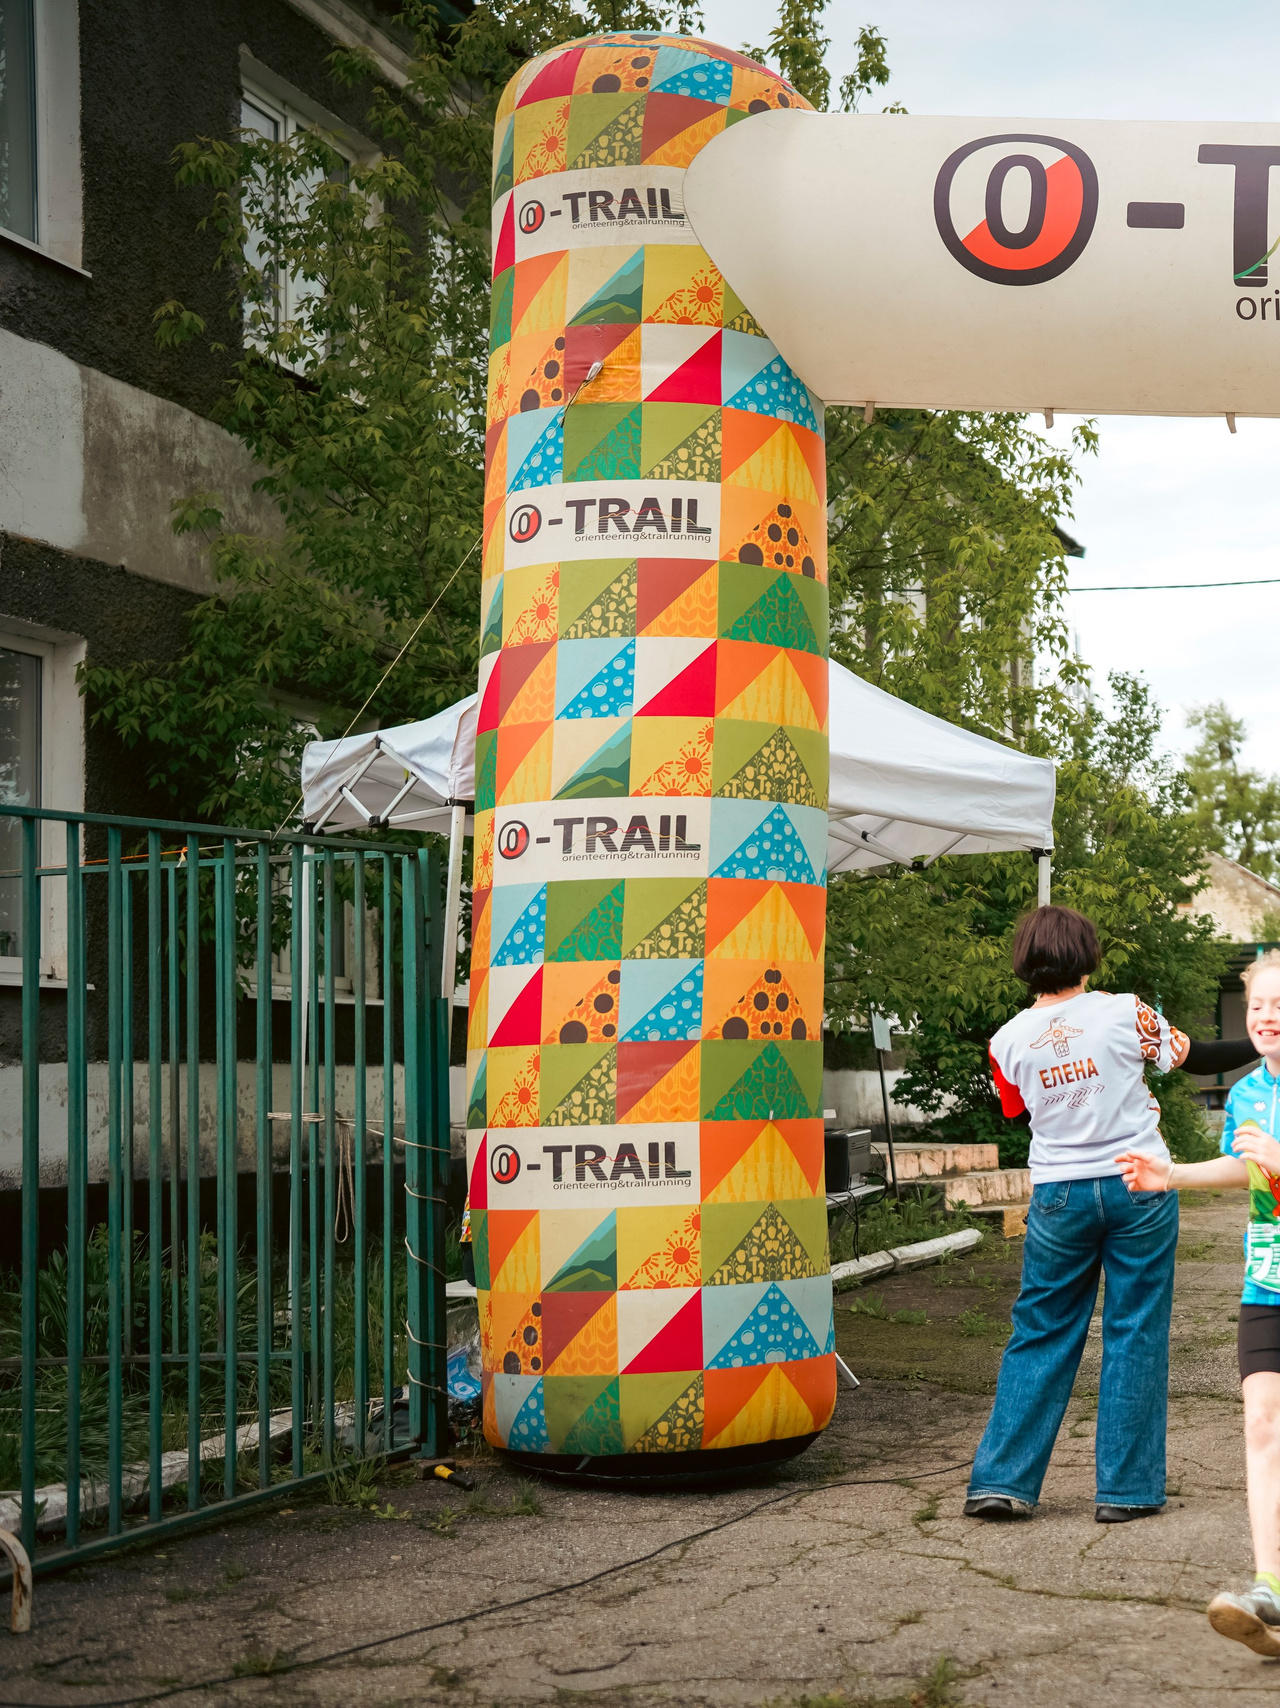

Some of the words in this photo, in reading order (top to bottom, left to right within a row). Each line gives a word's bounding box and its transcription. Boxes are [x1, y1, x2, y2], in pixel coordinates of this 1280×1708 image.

[572, 217, 685, 230] orienteering&trailrunning
[574, 531, 712, 544] orienteering&trailrunning
[562, 849, 701, 862] orienteering&trailrunning
[1038, 1057, 1099, 1090] ЕЛЕНА
[553, 1176, 692, 1191] orienteering&trailrunning
